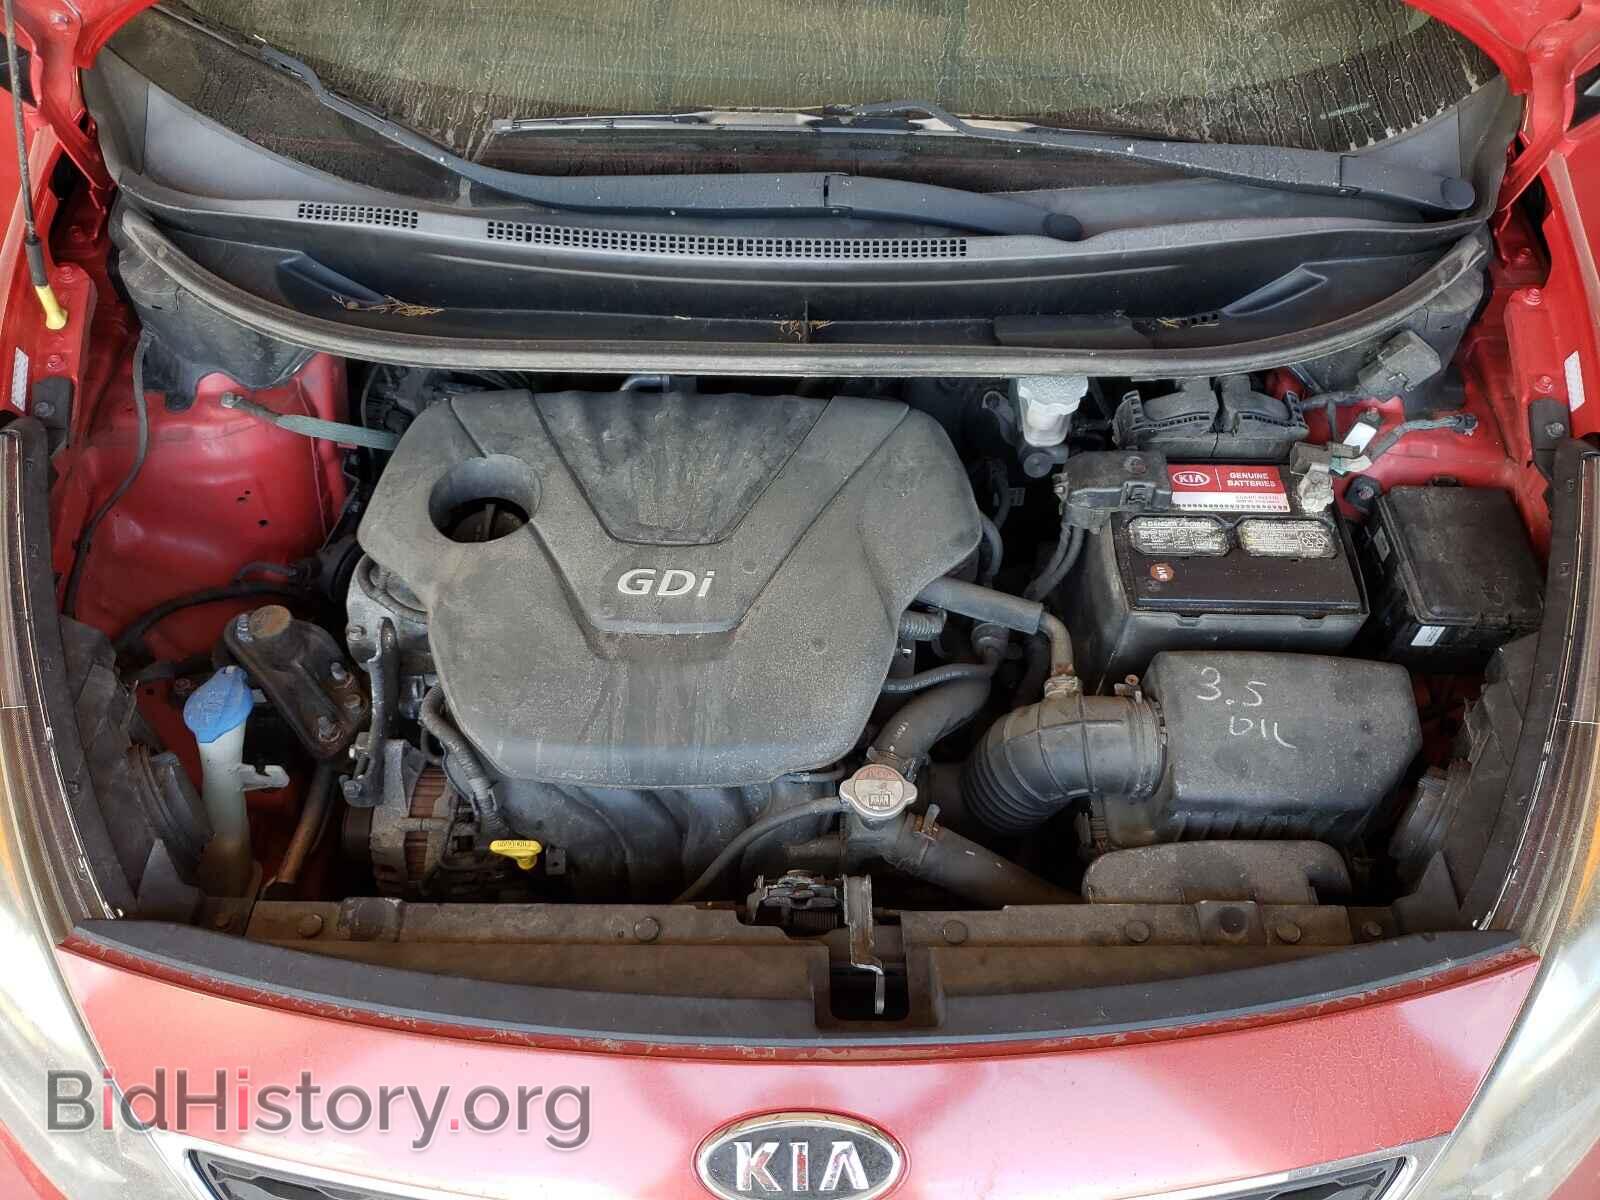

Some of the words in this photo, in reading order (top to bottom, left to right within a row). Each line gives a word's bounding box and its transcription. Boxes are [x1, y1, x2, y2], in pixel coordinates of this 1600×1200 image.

[1179, 474, 1205, 483] KIA
[1229, 472, 1270, 480] GENUINE
[617, 568, 715, 597] GDi
[1196, 666, 1267, 707] 3.5
[733, 1141, 870, 1192] KIA
